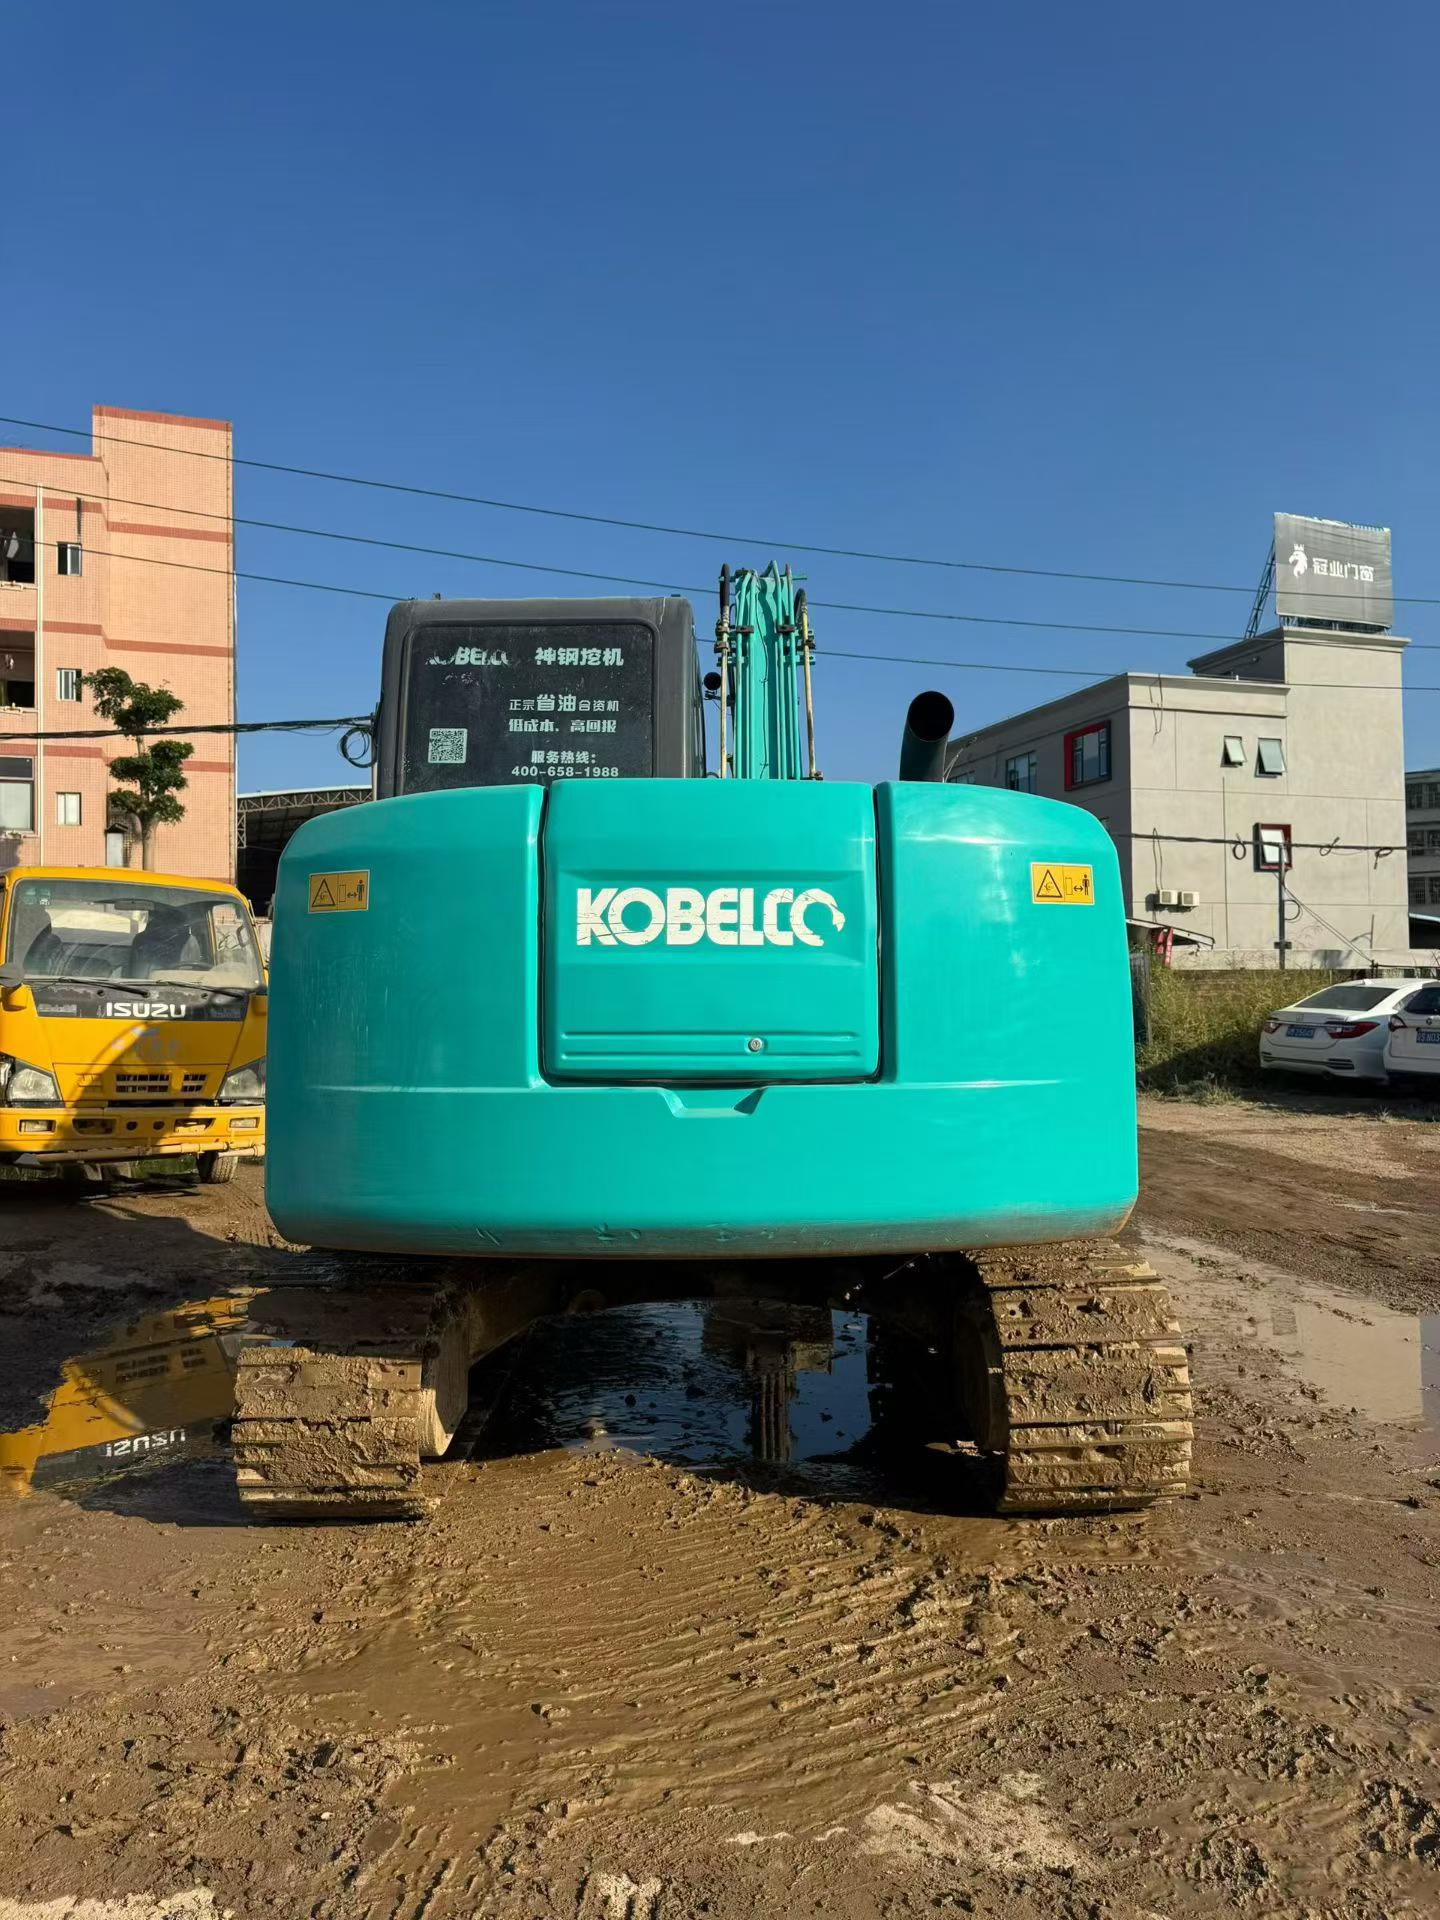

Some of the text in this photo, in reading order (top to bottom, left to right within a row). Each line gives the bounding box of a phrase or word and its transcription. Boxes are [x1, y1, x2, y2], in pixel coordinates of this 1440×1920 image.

[1312, 557, 1375, 582] 冠业门窗
[534, 647, 625, 666] 神钢挖机
[509, 693, 620, 712] 正宗省油合资机
[511, 765, 619, 778] 400-658-1988
[576, 886, 846, 947] KOBELCO
[105, 1002, 187, 1018] ISUZU
